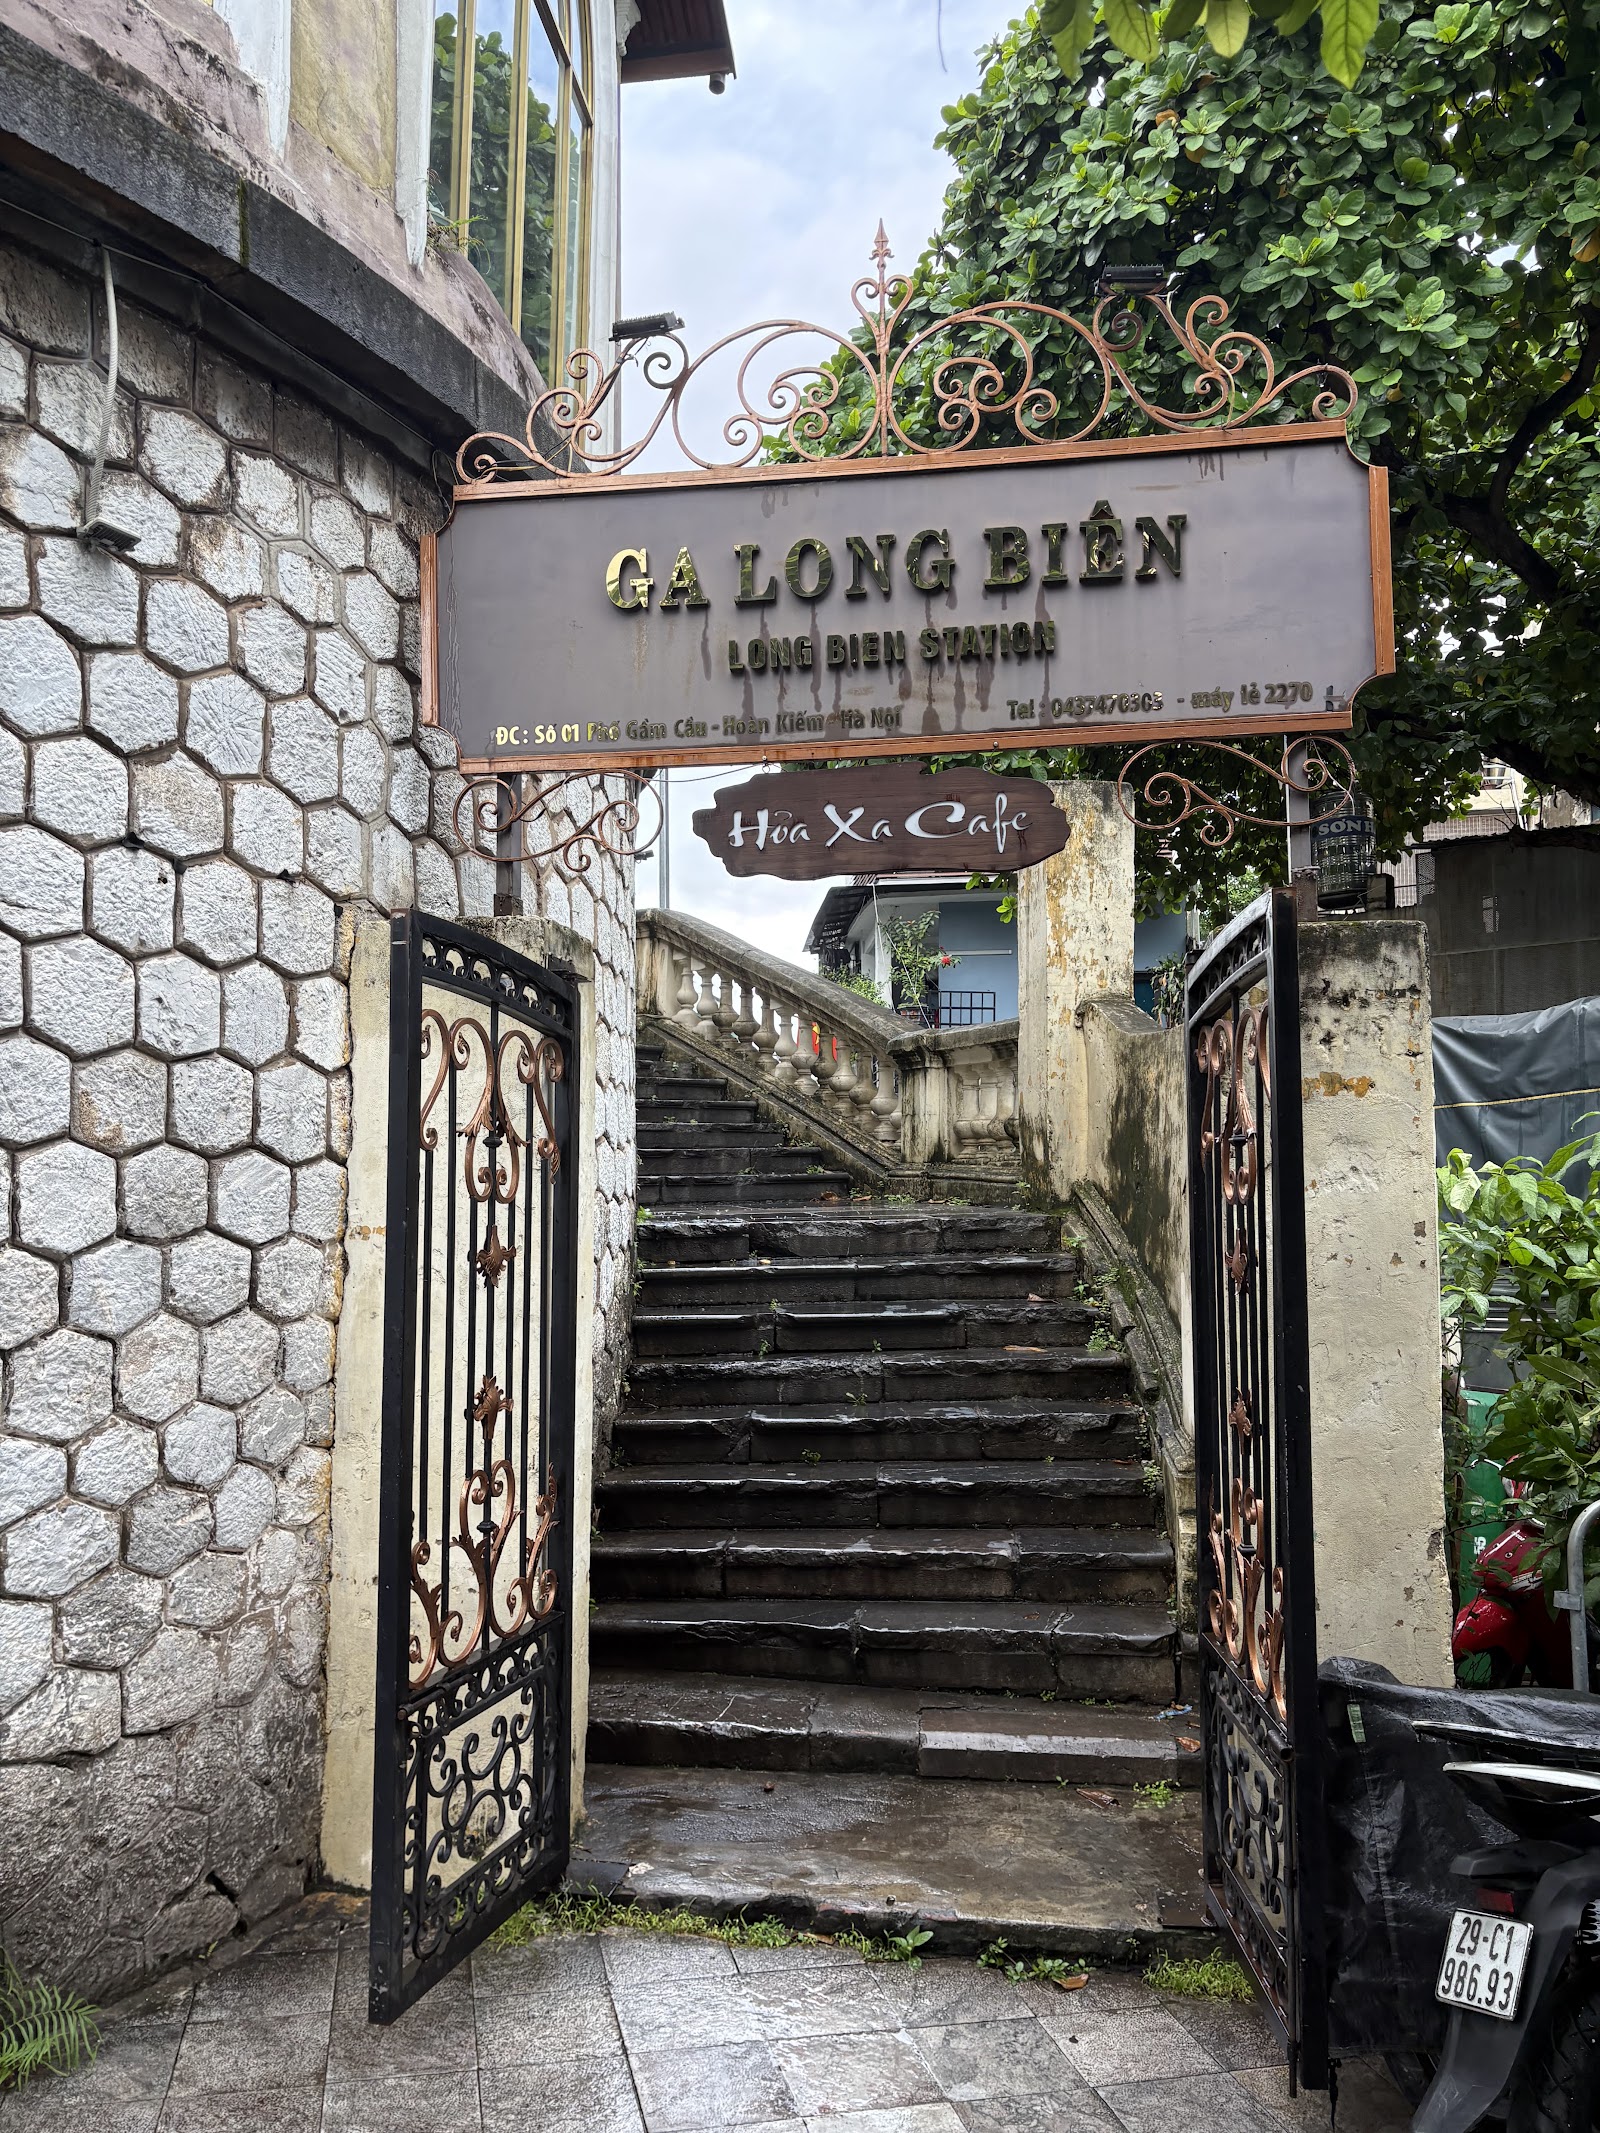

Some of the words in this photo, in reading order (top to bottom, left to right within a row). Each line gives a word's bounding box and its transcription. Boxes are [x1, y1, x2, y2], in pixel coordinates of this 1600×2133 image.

[605, 547, 708, 611] GA
[734, 528, 957, 605] LONG
[984, 500, 1188, 589] BIÊN
[728, 635, 813, 673] LONG
[826, 630, 906, 668] BIEN
[919, 620, 1055, 659] STATION
[1191, 686, 1234, 713] máy
[1265, 681, 1313, 704] 2270
[495, 725, 529, 746] ĐC:
[534, 723, 557, 744] Số
[560, 723, 580, 742] 01
[586, 720, 622, 742] Phố
[625, 718, 667, 741] Gầm
[673, 715, 706, 738] Cầu
[722, 712, 770, 736] Hoàn
[775, 709, 825, 734] Kiếm
[841, 709, 864, 729] Hà
[871, 706, 902, 732] Nội
[728, 808, 811, 851] Hỏa
[823, 803, 893, 848] Xa
[905, 792, 1034, 854] Cafe
[1318, 818, 1361, 836] SƠN
[1364, 820, 1375, 833] H
[1455, 1916, 1515, 1965] 29-C1
[1441, 1957, 1514, 2011] 986.93
